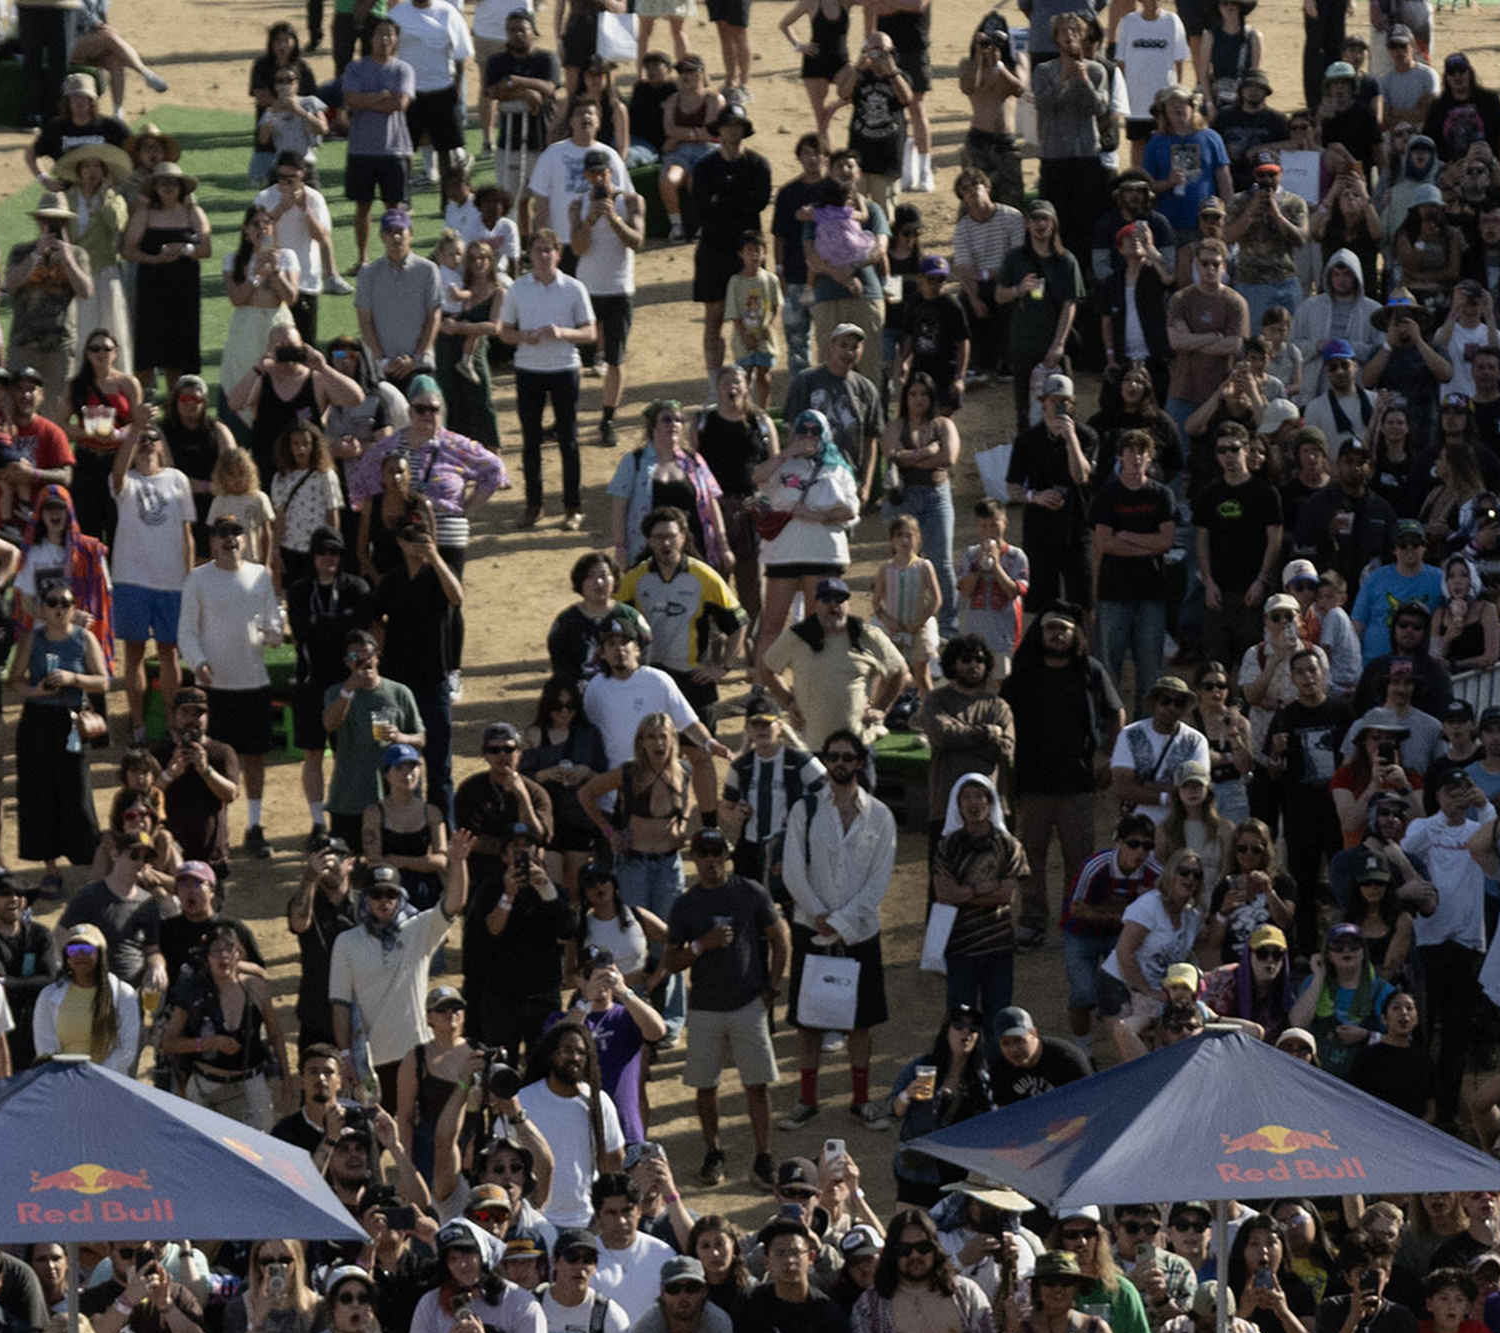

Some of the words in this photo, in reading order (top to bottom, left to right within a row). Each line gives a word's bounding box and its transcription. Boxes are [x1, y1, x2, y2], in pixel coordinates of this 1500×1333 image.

[1217, 1160, 1288, 1183] Red
[1295, 1156, 1366, 1181] Bull
[16, 1200, 93, 1225] Red
[100, 1198, 175, 1224] Bull
